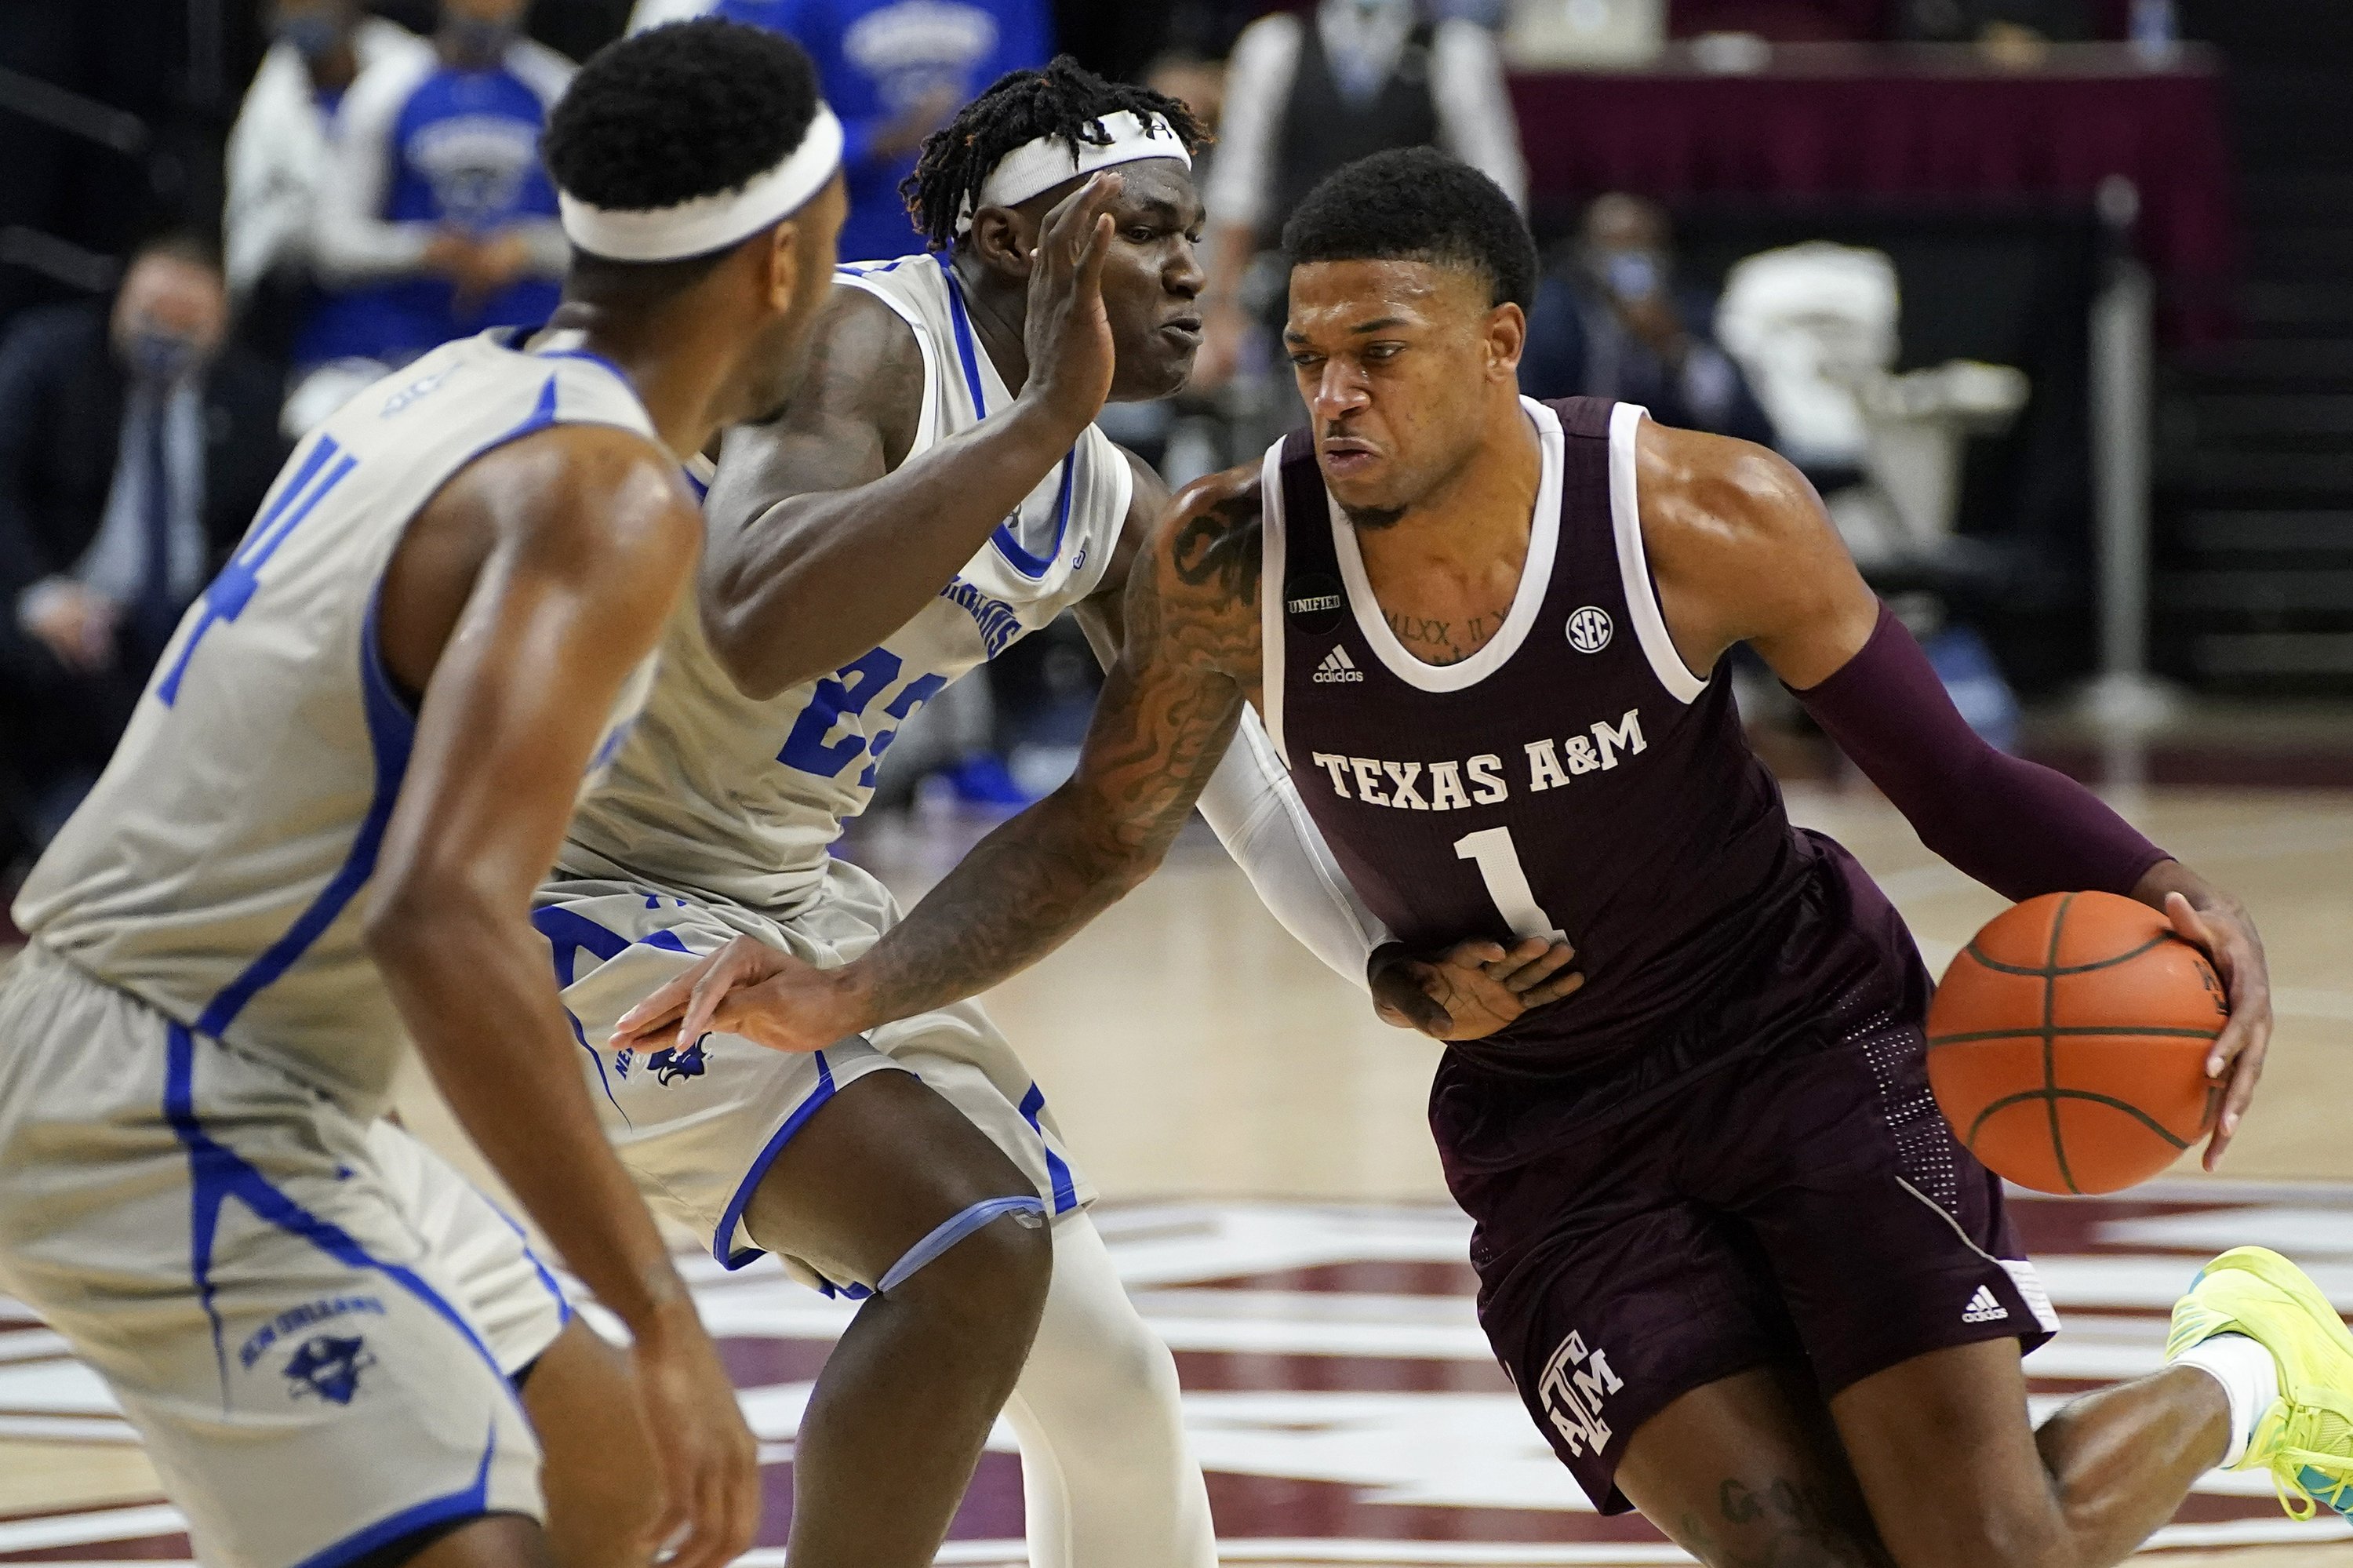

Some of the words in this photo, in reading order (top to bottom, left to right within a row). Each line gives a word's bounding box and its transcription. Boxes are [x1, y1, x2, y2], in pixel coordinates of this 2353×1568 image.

[1288, 595, 1340, 614] UNIFIED
[1569, 610, 1609, 649] SEC
[1312, 668, 1364, 683] adidas
[1312, 751, 1509, 811] TEXAS
[1524, 708, 1648, 792] A&M
[1453, 825, 1570, 949] 1
